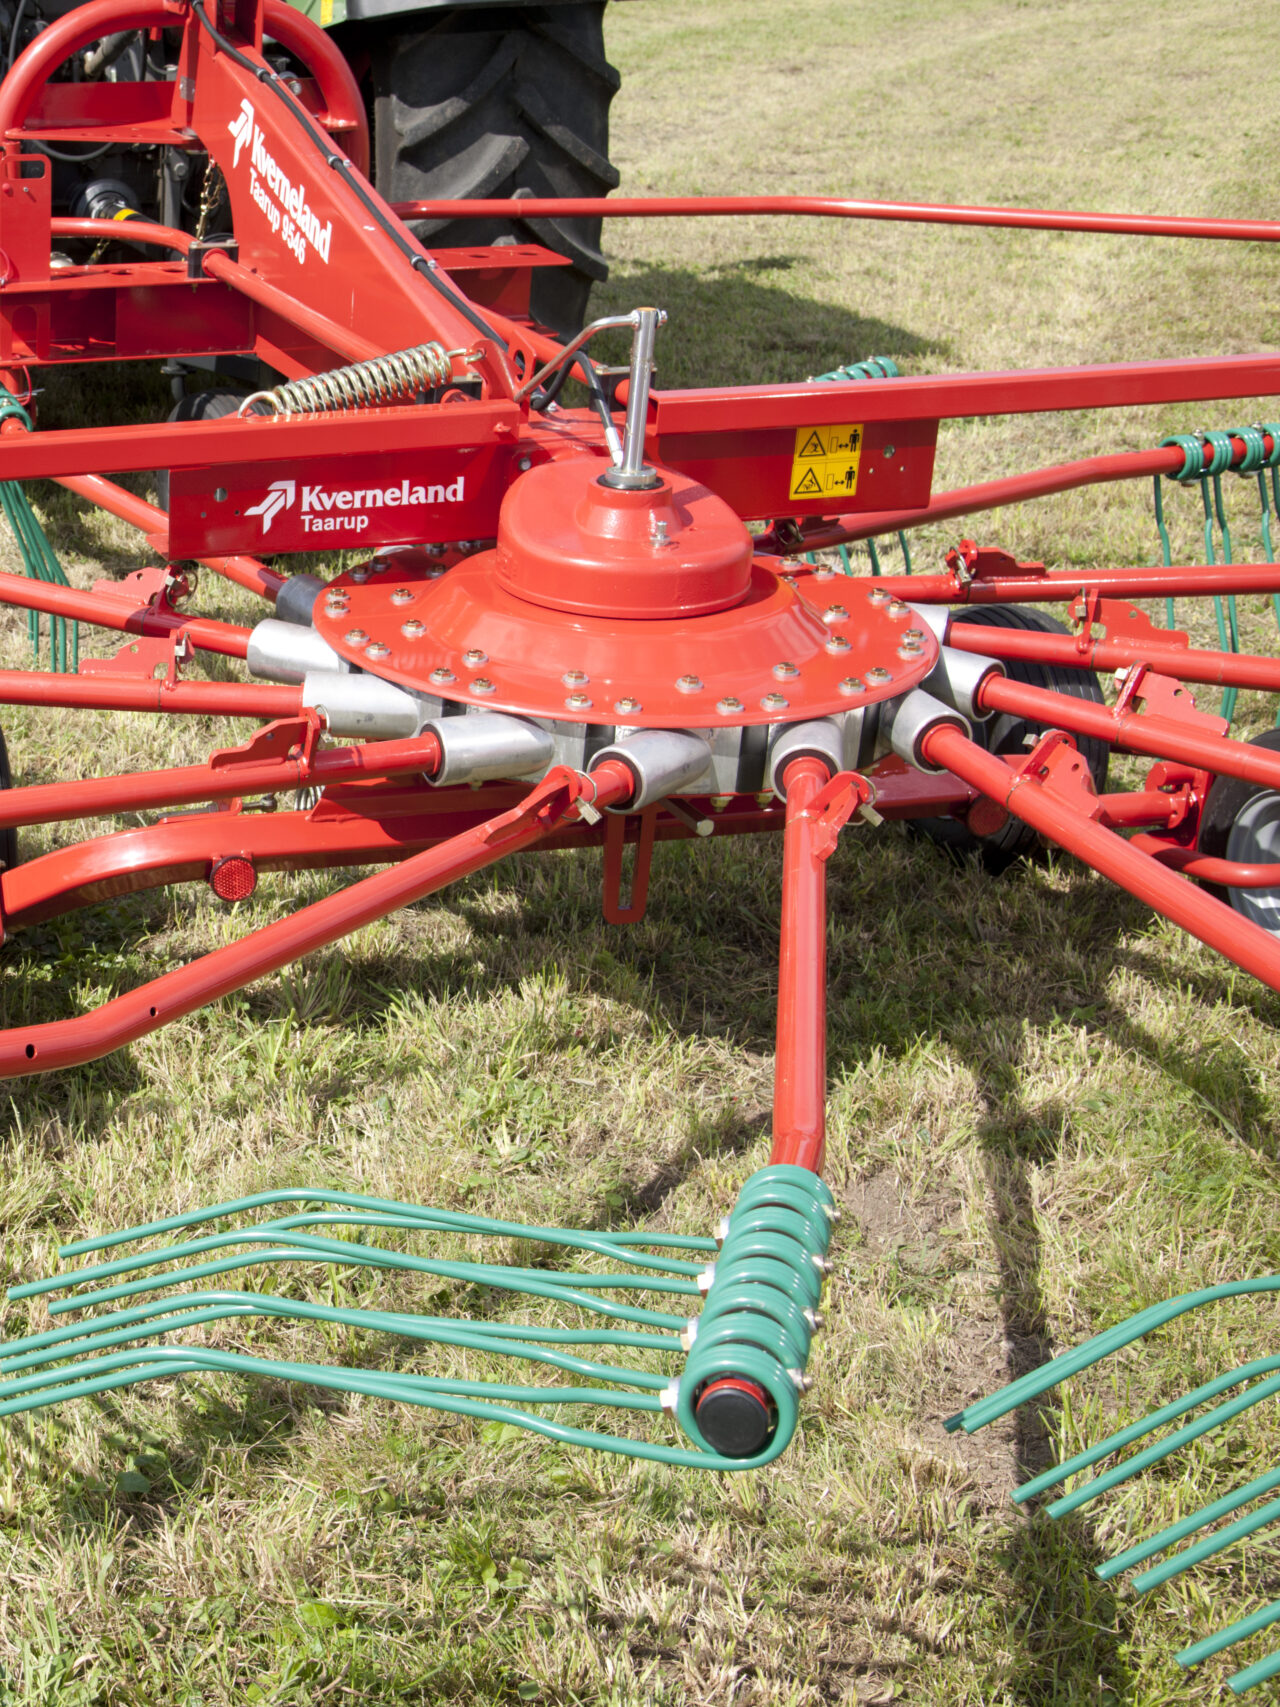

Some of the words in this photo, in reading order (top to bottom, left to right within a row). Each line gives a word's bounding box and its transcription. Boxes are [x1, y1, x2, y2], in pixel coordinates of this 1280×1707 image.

[250, 167, 280, 233] Taarup
[281, 214, 306, 265] 9546
[251, 124, 332, 264] Kverneland
[300, 514, 369, 533] Taarup
[301, 476, 465, 512] Kverneland
